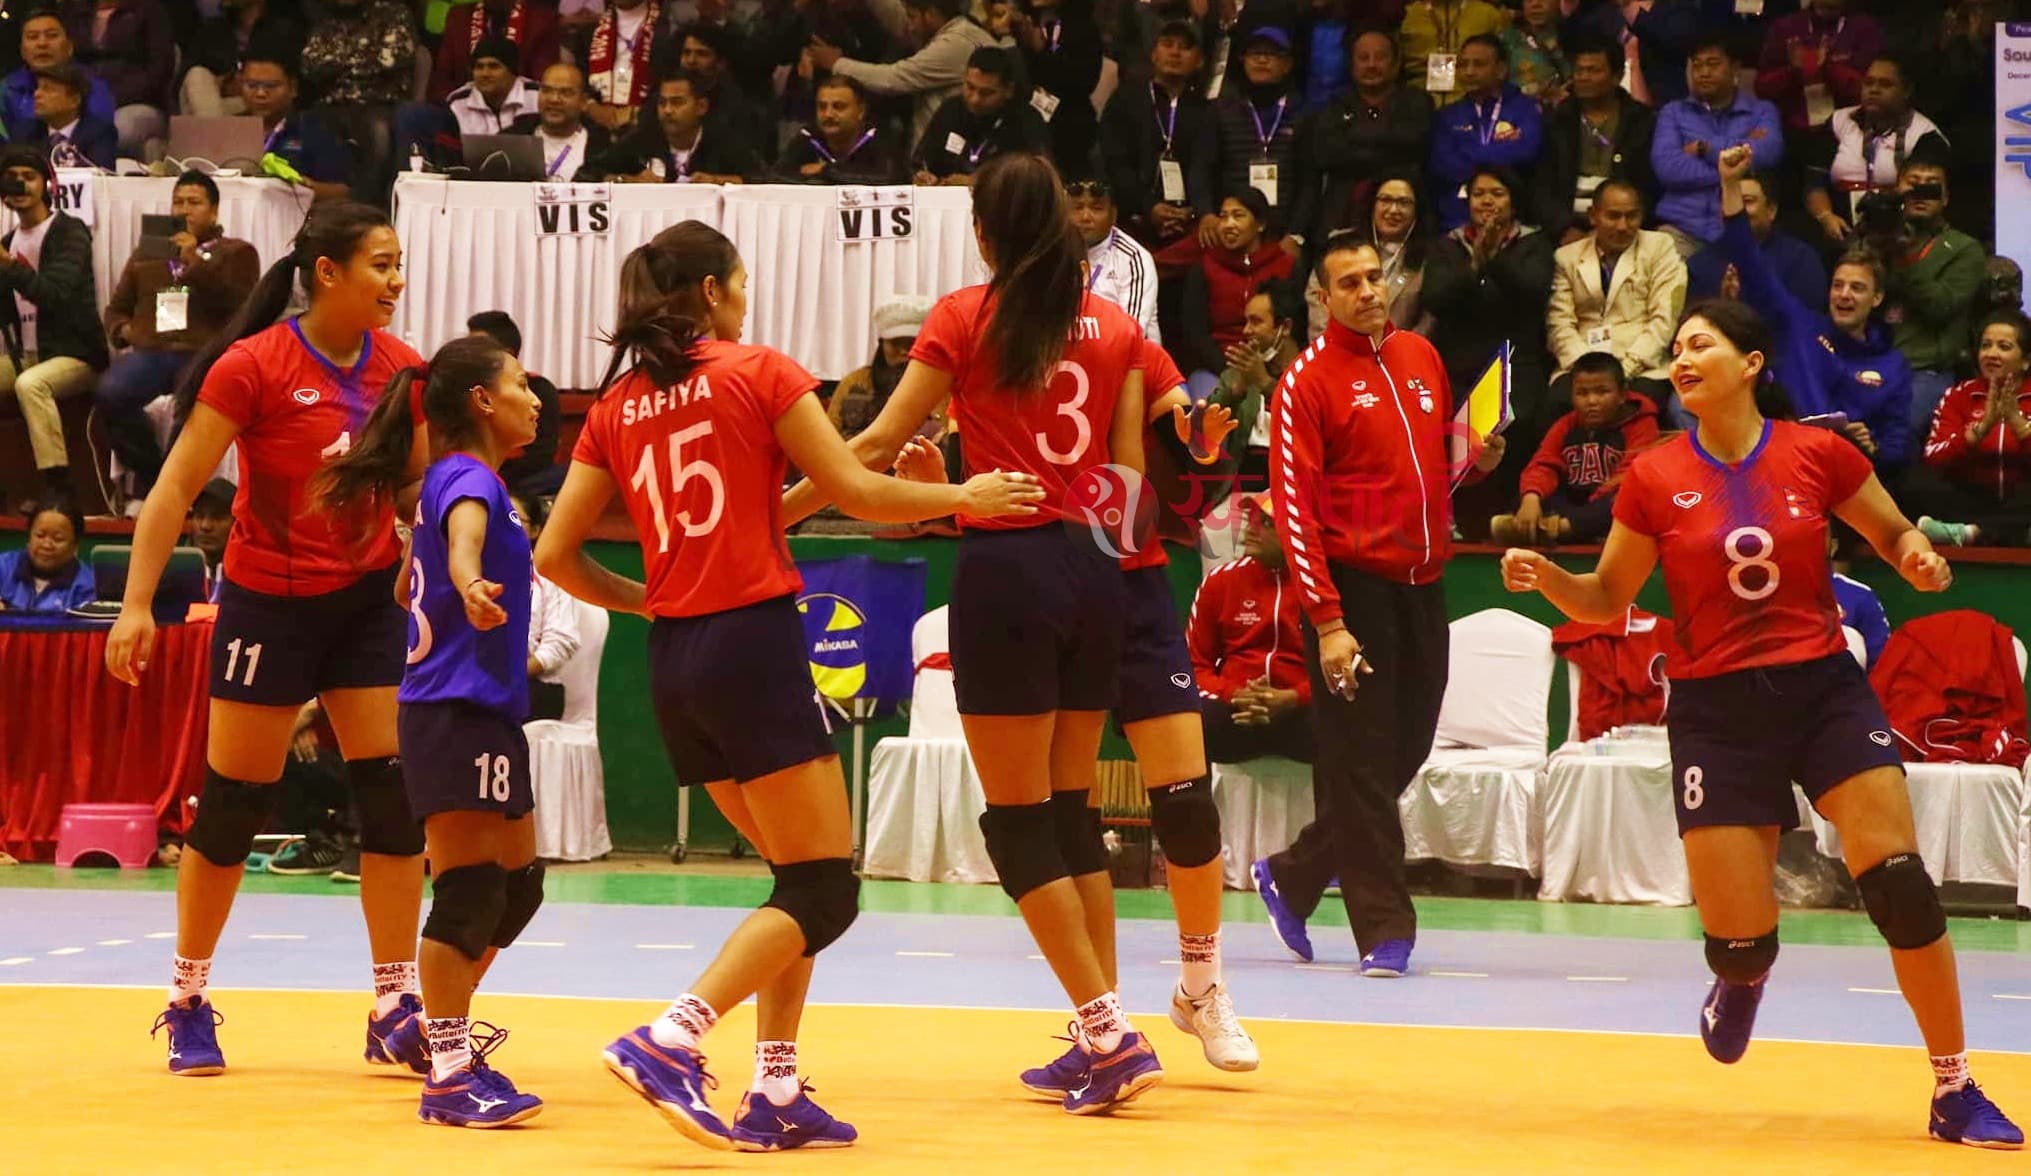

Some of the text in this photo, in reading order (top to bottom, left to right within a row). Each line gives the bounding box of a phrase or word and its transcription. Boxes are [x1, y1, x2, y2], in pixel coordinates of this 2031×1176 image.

[538, 202, 609, 233] VIS
[840, 206, 912, 238] VIS
[622, 374, 712, 426] SAFIYA
[1035, 360, 1092, 465] 3
[630, 419, 725, 554] 15
[1724, 526, 1780, 600] 8
[224, 638, 262, 686] 11
[474, 752, 510, 802] 18
[1684, 765, 1704, 810] 8
